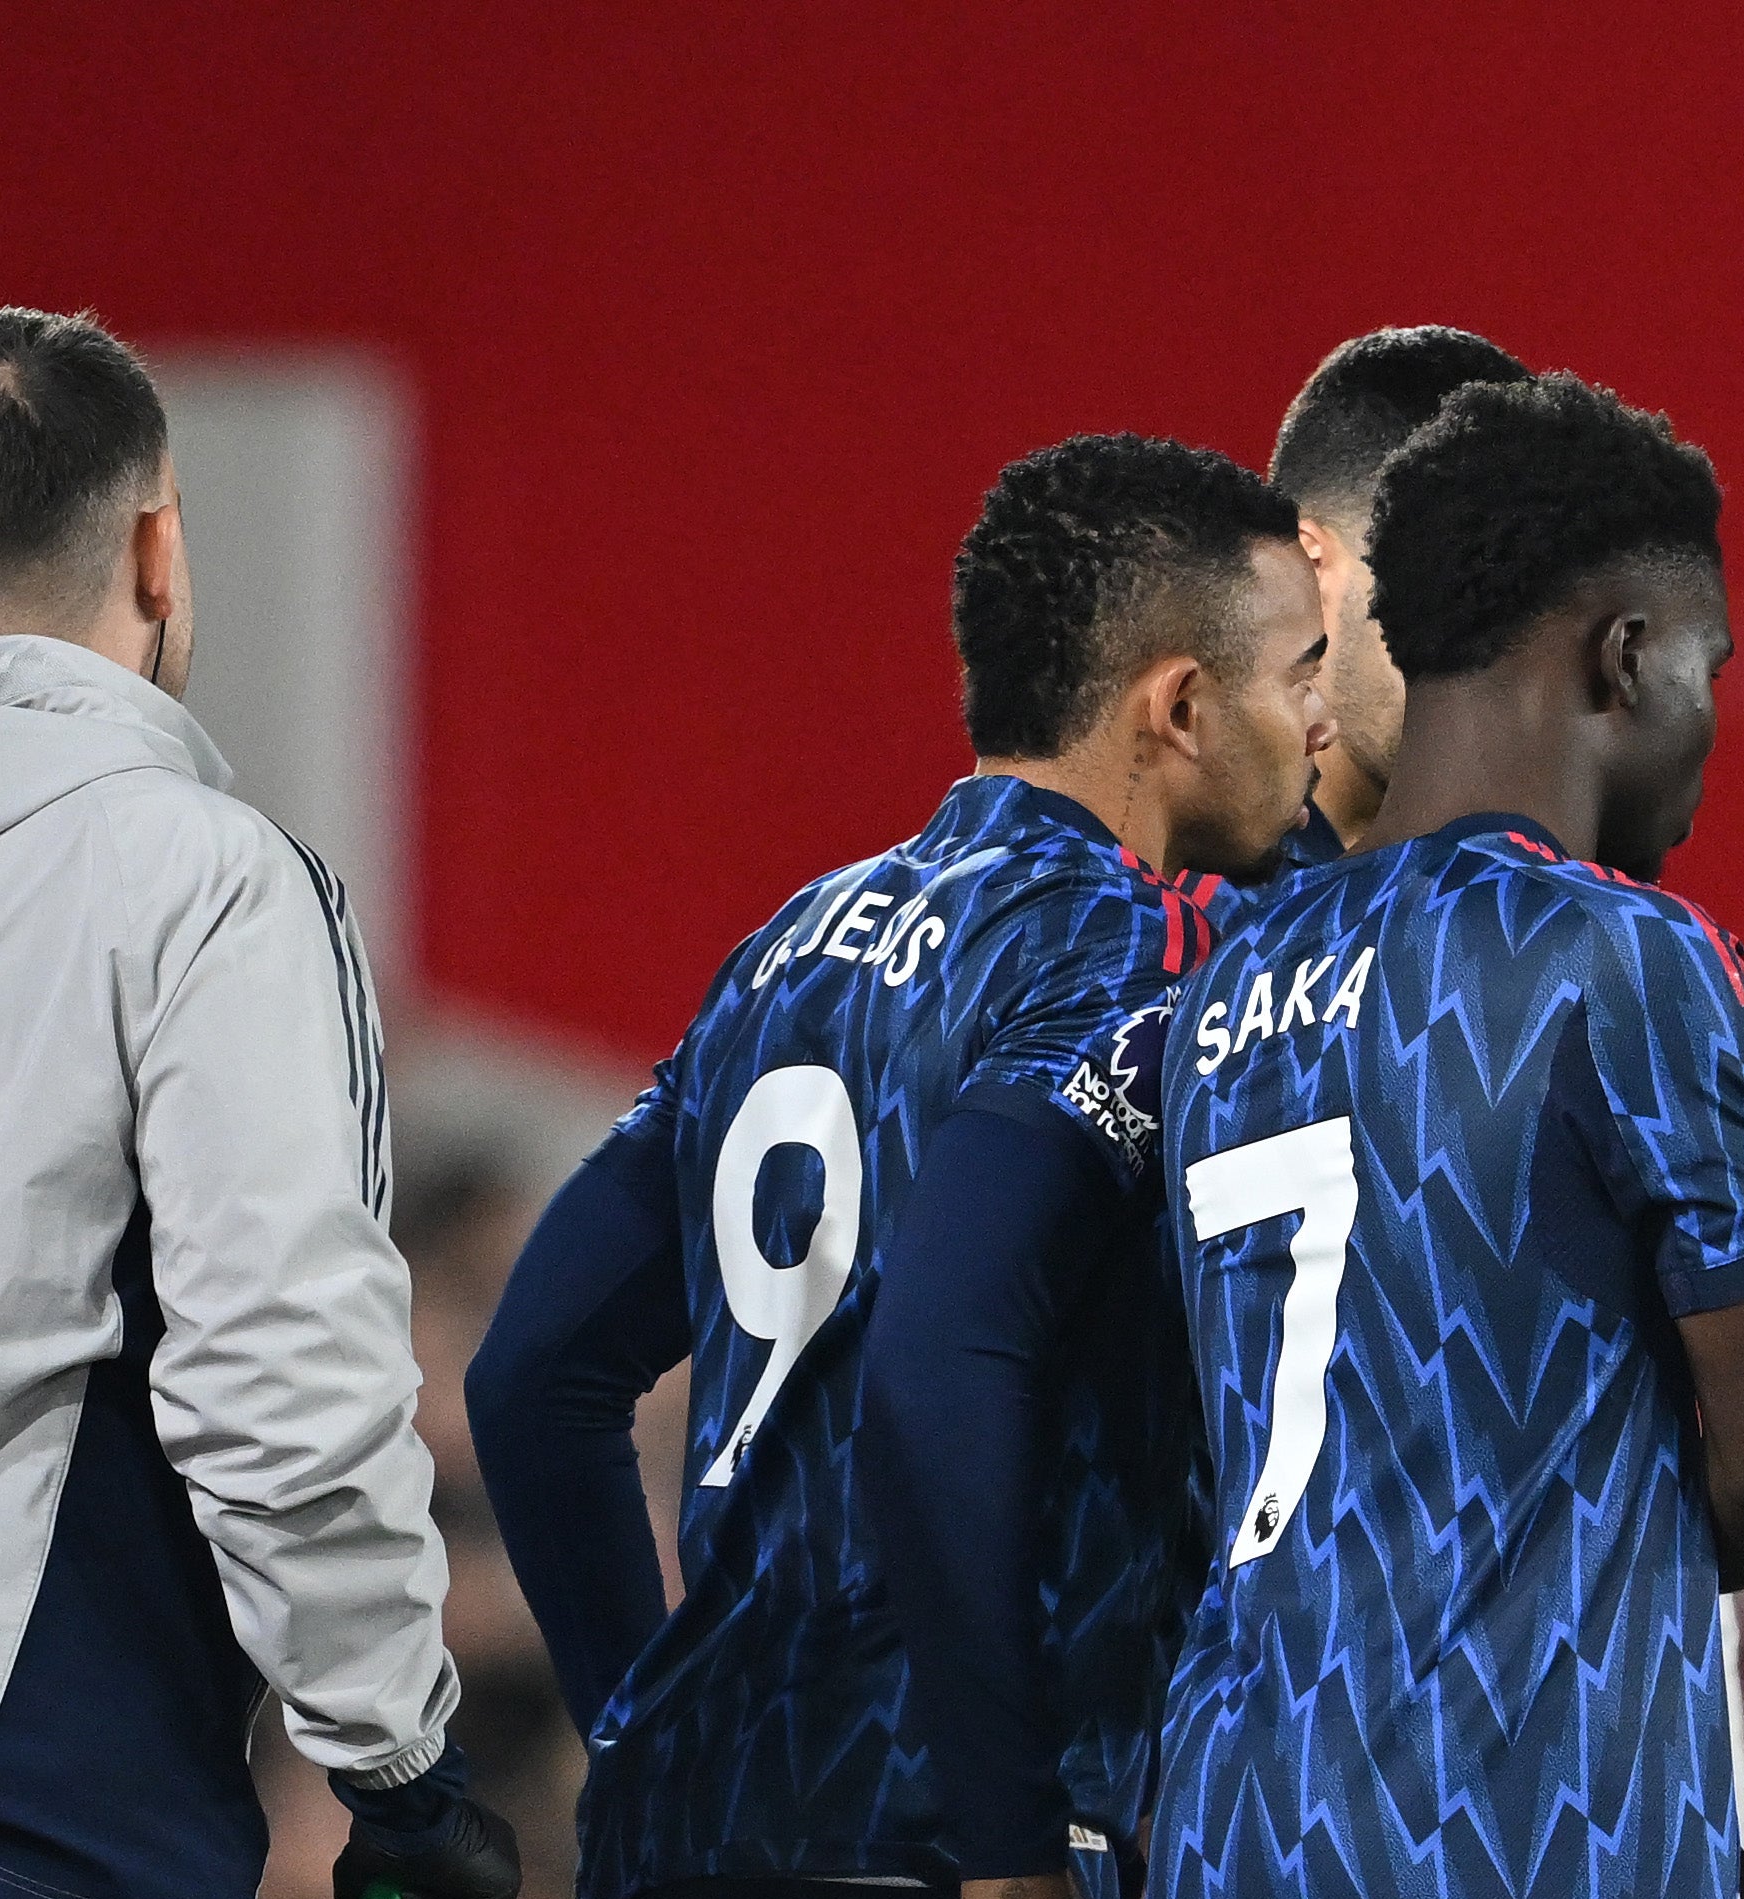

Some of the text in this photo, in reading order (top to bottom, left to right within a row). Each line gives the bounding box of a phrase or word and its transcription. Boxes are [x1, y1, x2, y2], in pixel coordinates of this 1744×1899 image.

[1072, 1061, 1110, 1101] No
[1195, 946, 1376, 1076] SAKA
[699, 1065, 863, 1487] 9
[1185, 1115, 1359, 1569] 7
